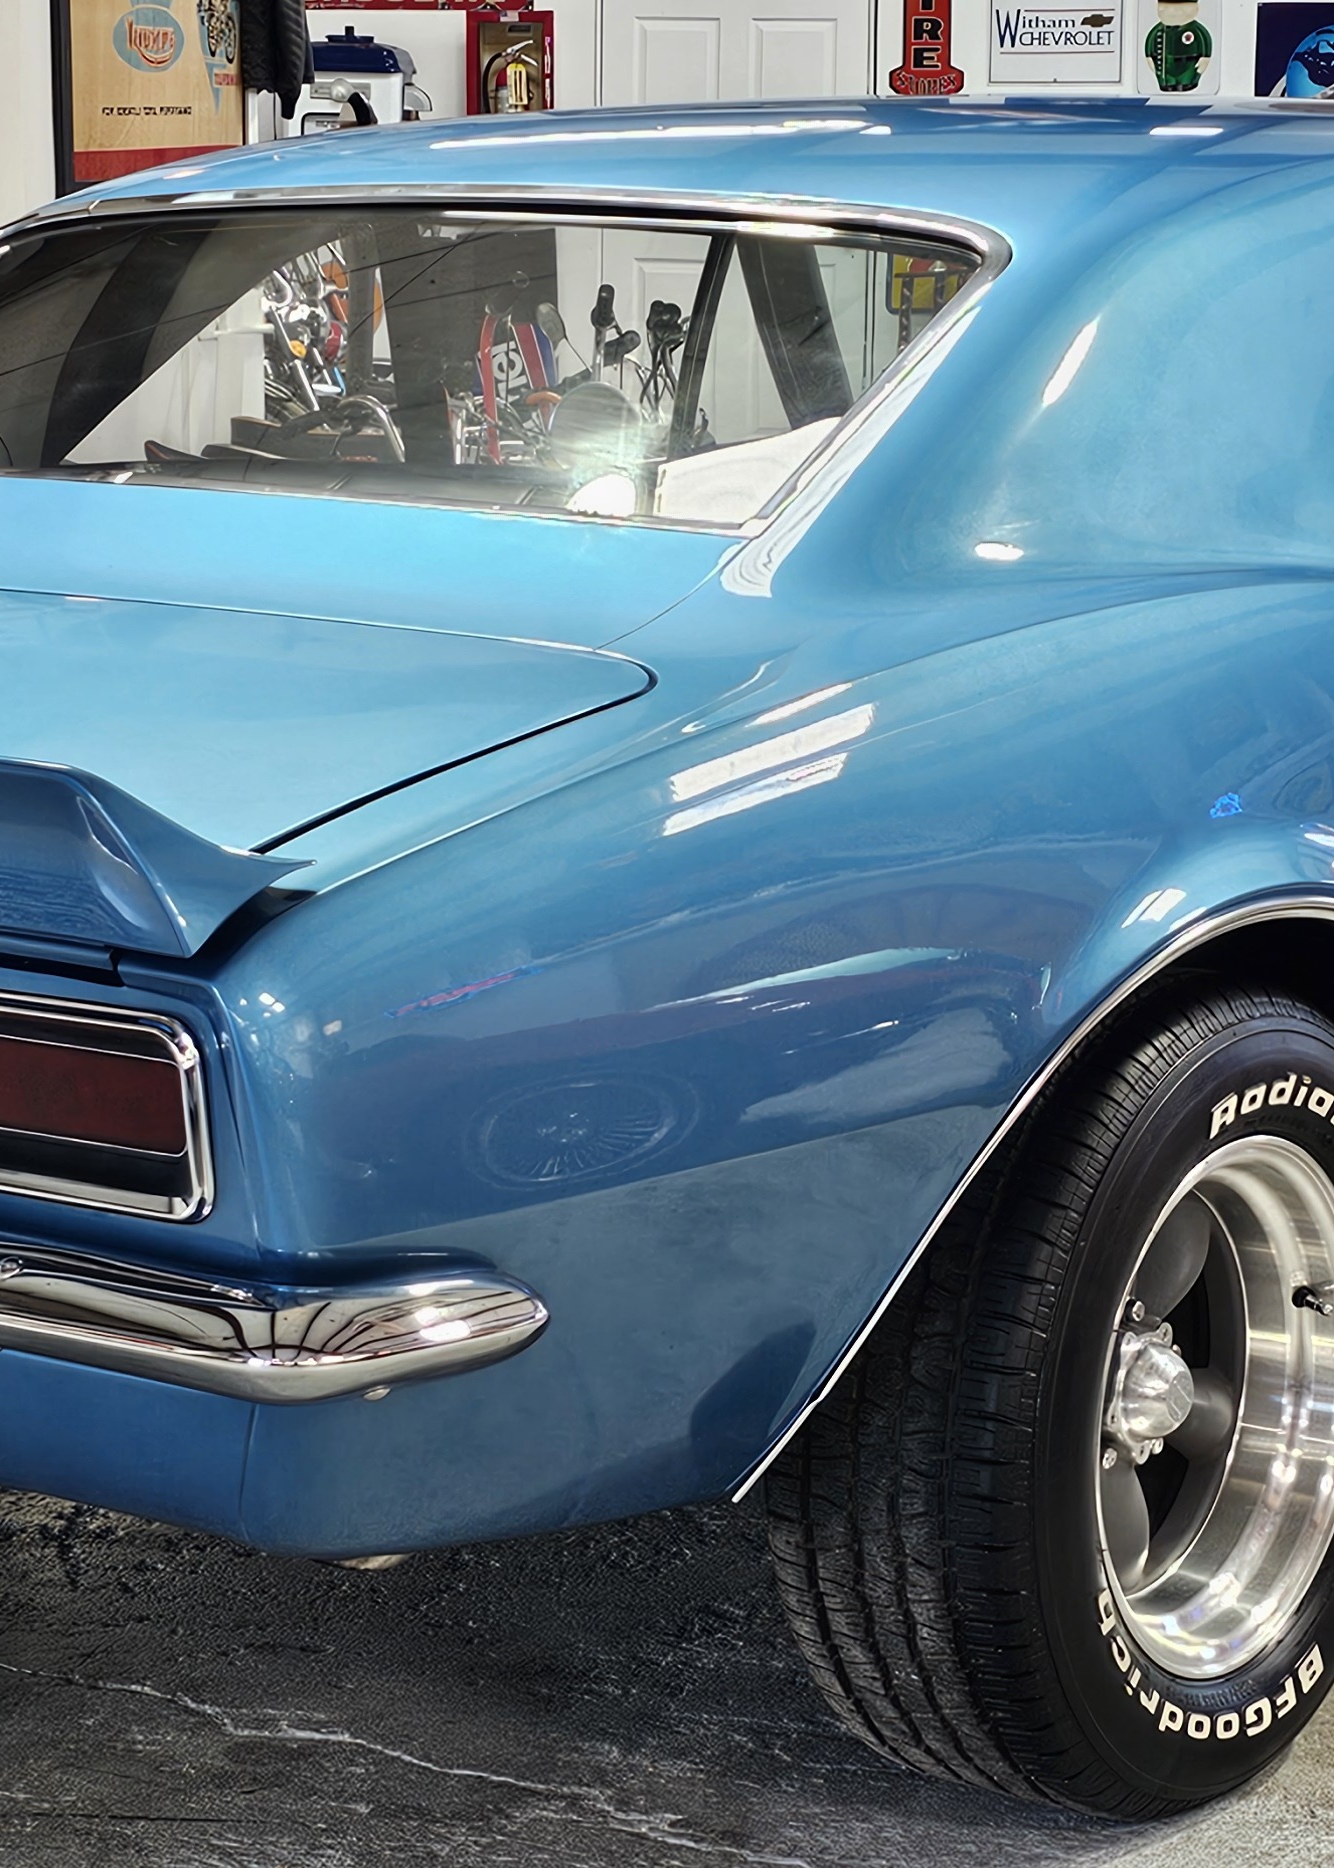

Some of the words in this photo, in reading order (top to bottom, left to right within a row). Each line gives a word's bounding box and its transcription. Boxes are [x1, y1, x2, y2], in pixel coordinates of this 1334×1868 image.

[995, 9, 1075, 48] Witham
[1019, 30, 1115, 47] CHEVROLET
[1097, 1587, 1325, 1741] BFGoodrich
